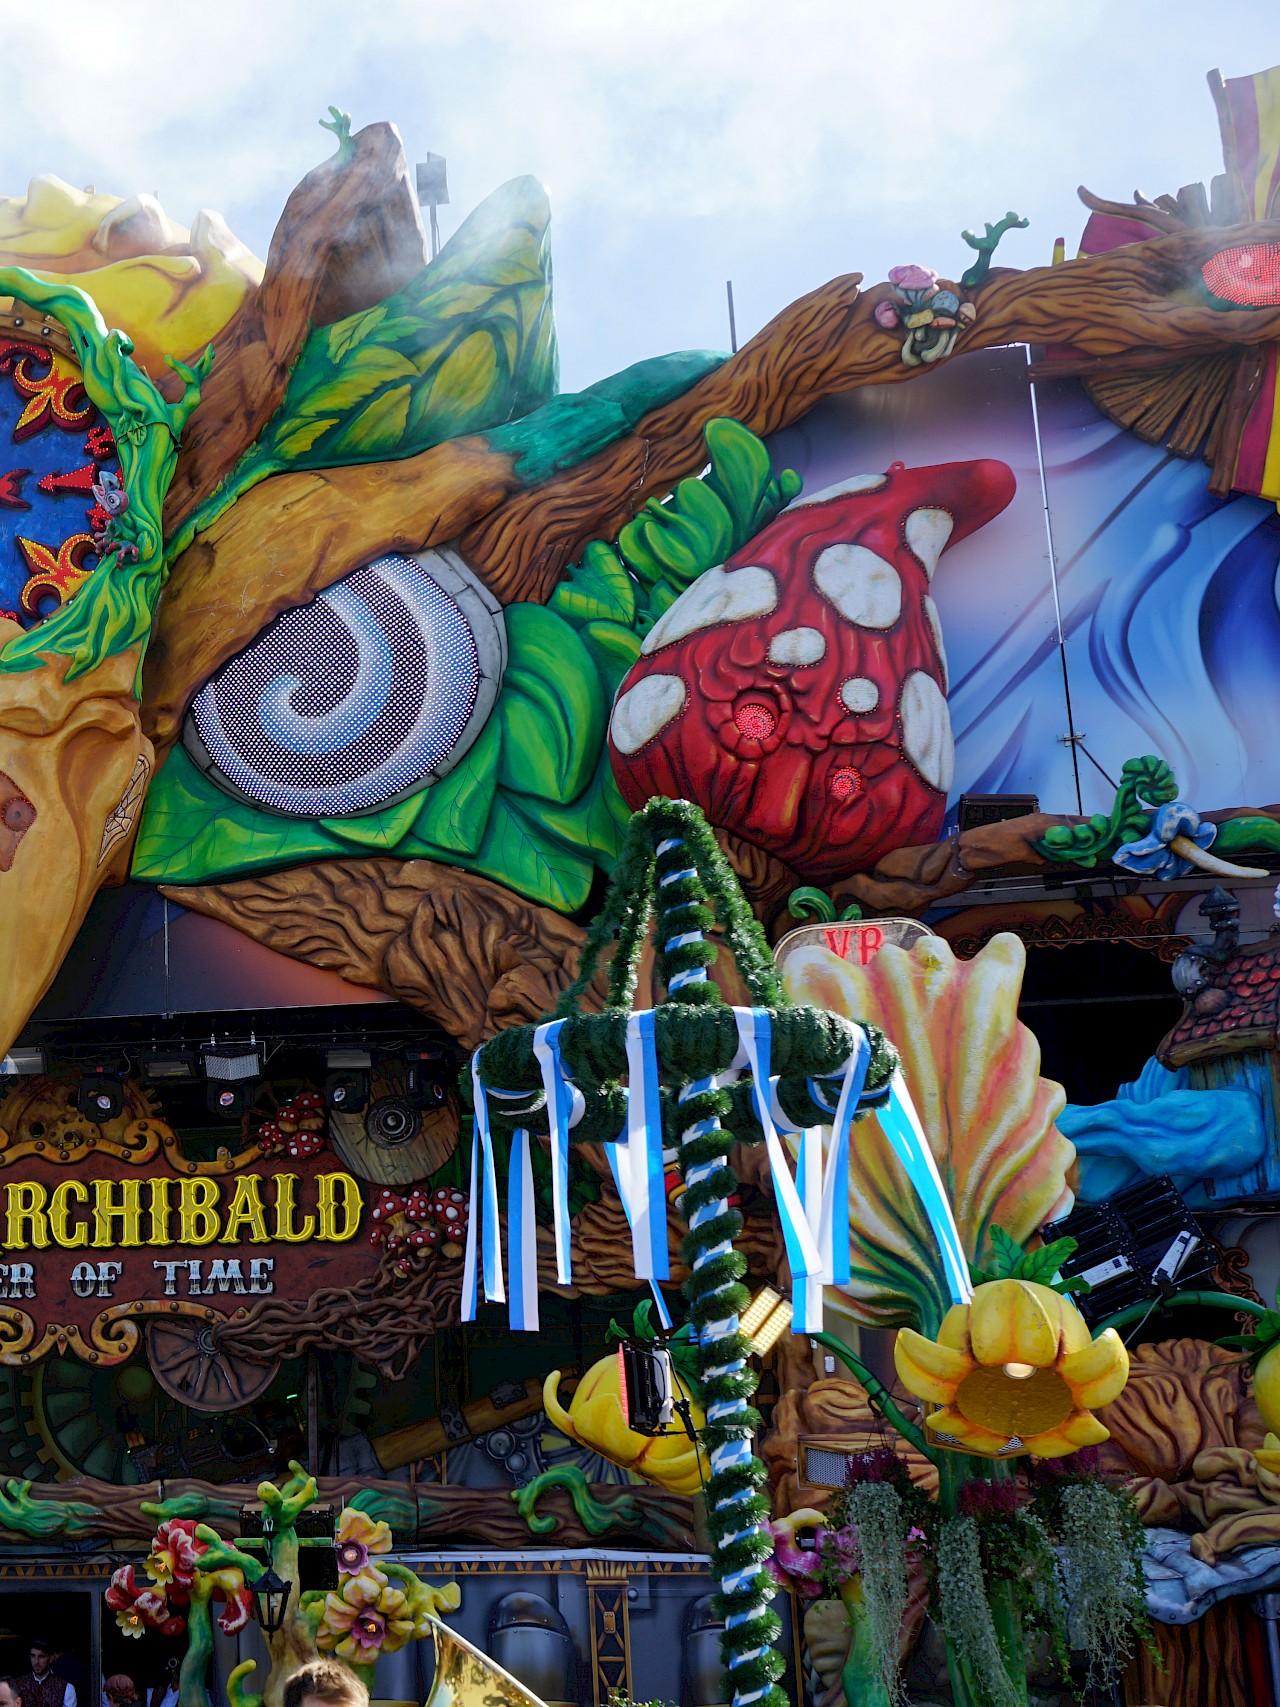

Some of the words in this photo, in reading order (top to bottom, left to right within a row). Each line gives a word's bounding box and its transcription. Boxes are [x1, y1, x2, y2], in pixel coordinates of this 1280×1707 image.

[823, 926, 884, 965] VR
[70, 1261, 122, 1298] OF
[153, 1257, 276, 1296] TIME
